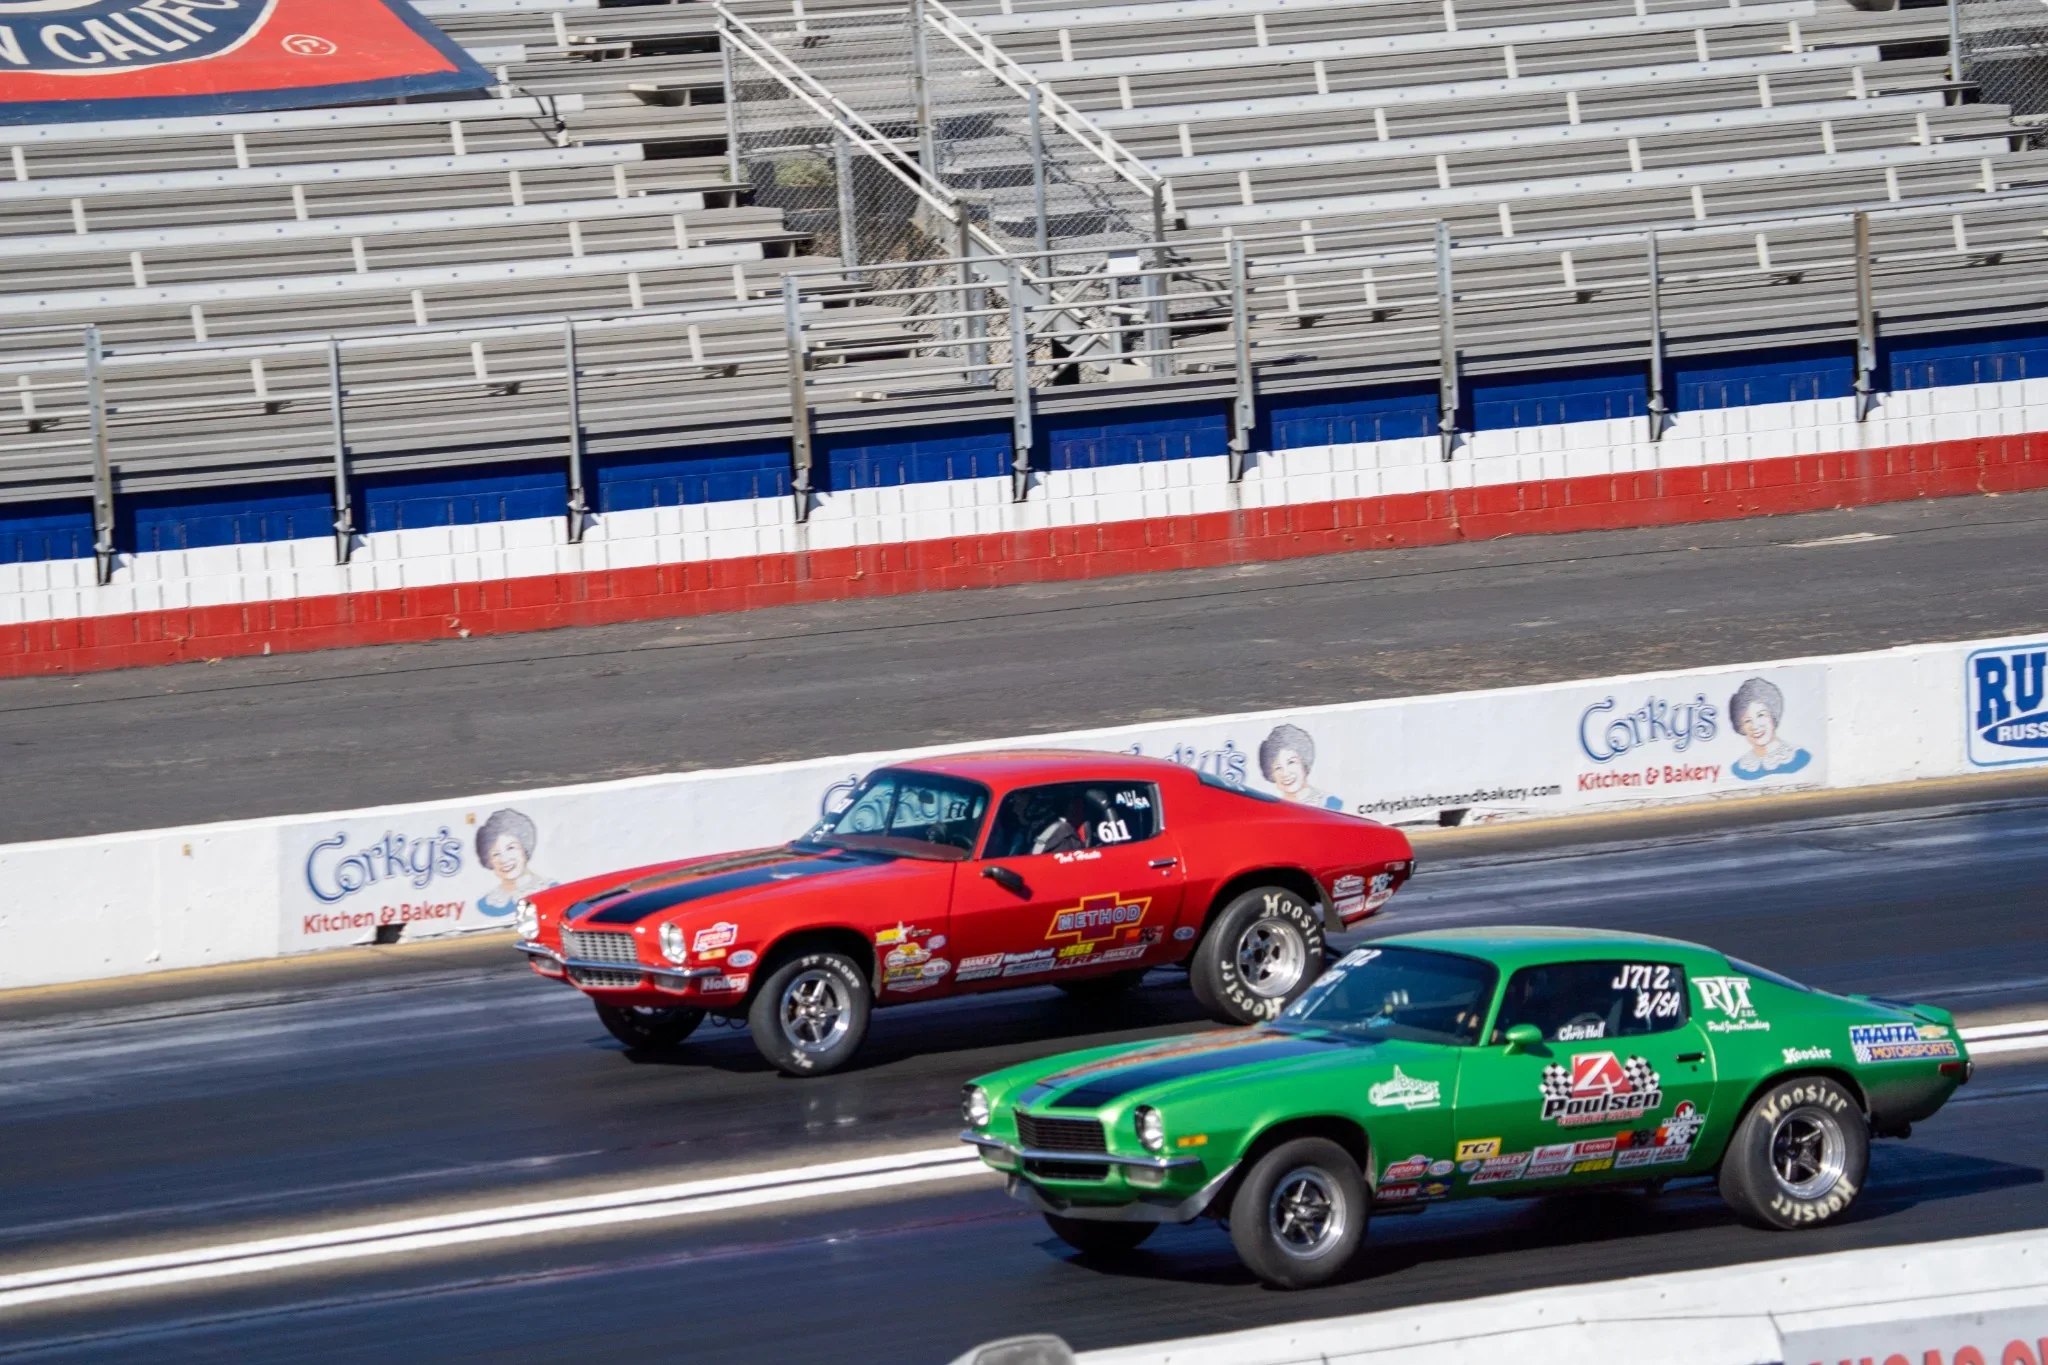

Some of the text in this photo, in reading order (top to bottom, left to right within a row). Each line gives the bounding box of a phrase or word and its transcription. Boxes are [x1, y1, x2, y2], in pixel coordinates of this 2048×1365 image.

[1578, 692, 1718, 764] Corky's
[1578, 763, 1721, 792] Kitchen & Bakery
[1358, 784, 1562, 814] corkyskitchenandbakery.com
[1098, 820, 1132, 843] 611
[306, 826, 463, 904] Corky's
[304, 900, 466, 934] Kitchen & Bakery
[1057, 905, 1141, 931] METHOD
[702, 974, 747, 992] Holley
[1612, 965, 1670, 990] J712
[1634, 992, 1681, 1018] B/SA
[1558, 1021, 1606, 1041] Chris Hall
[1852, 1026, 1919, 1044] MAITA
[1782, 1047, 1832, 1064] Hoosier
[1871, 1043, 1956, 1059] MOTORSPORTS
[1543, 1092, 1662, 1120] Poulsen
[1760, 1084, 1848, 1124] Hoosier
